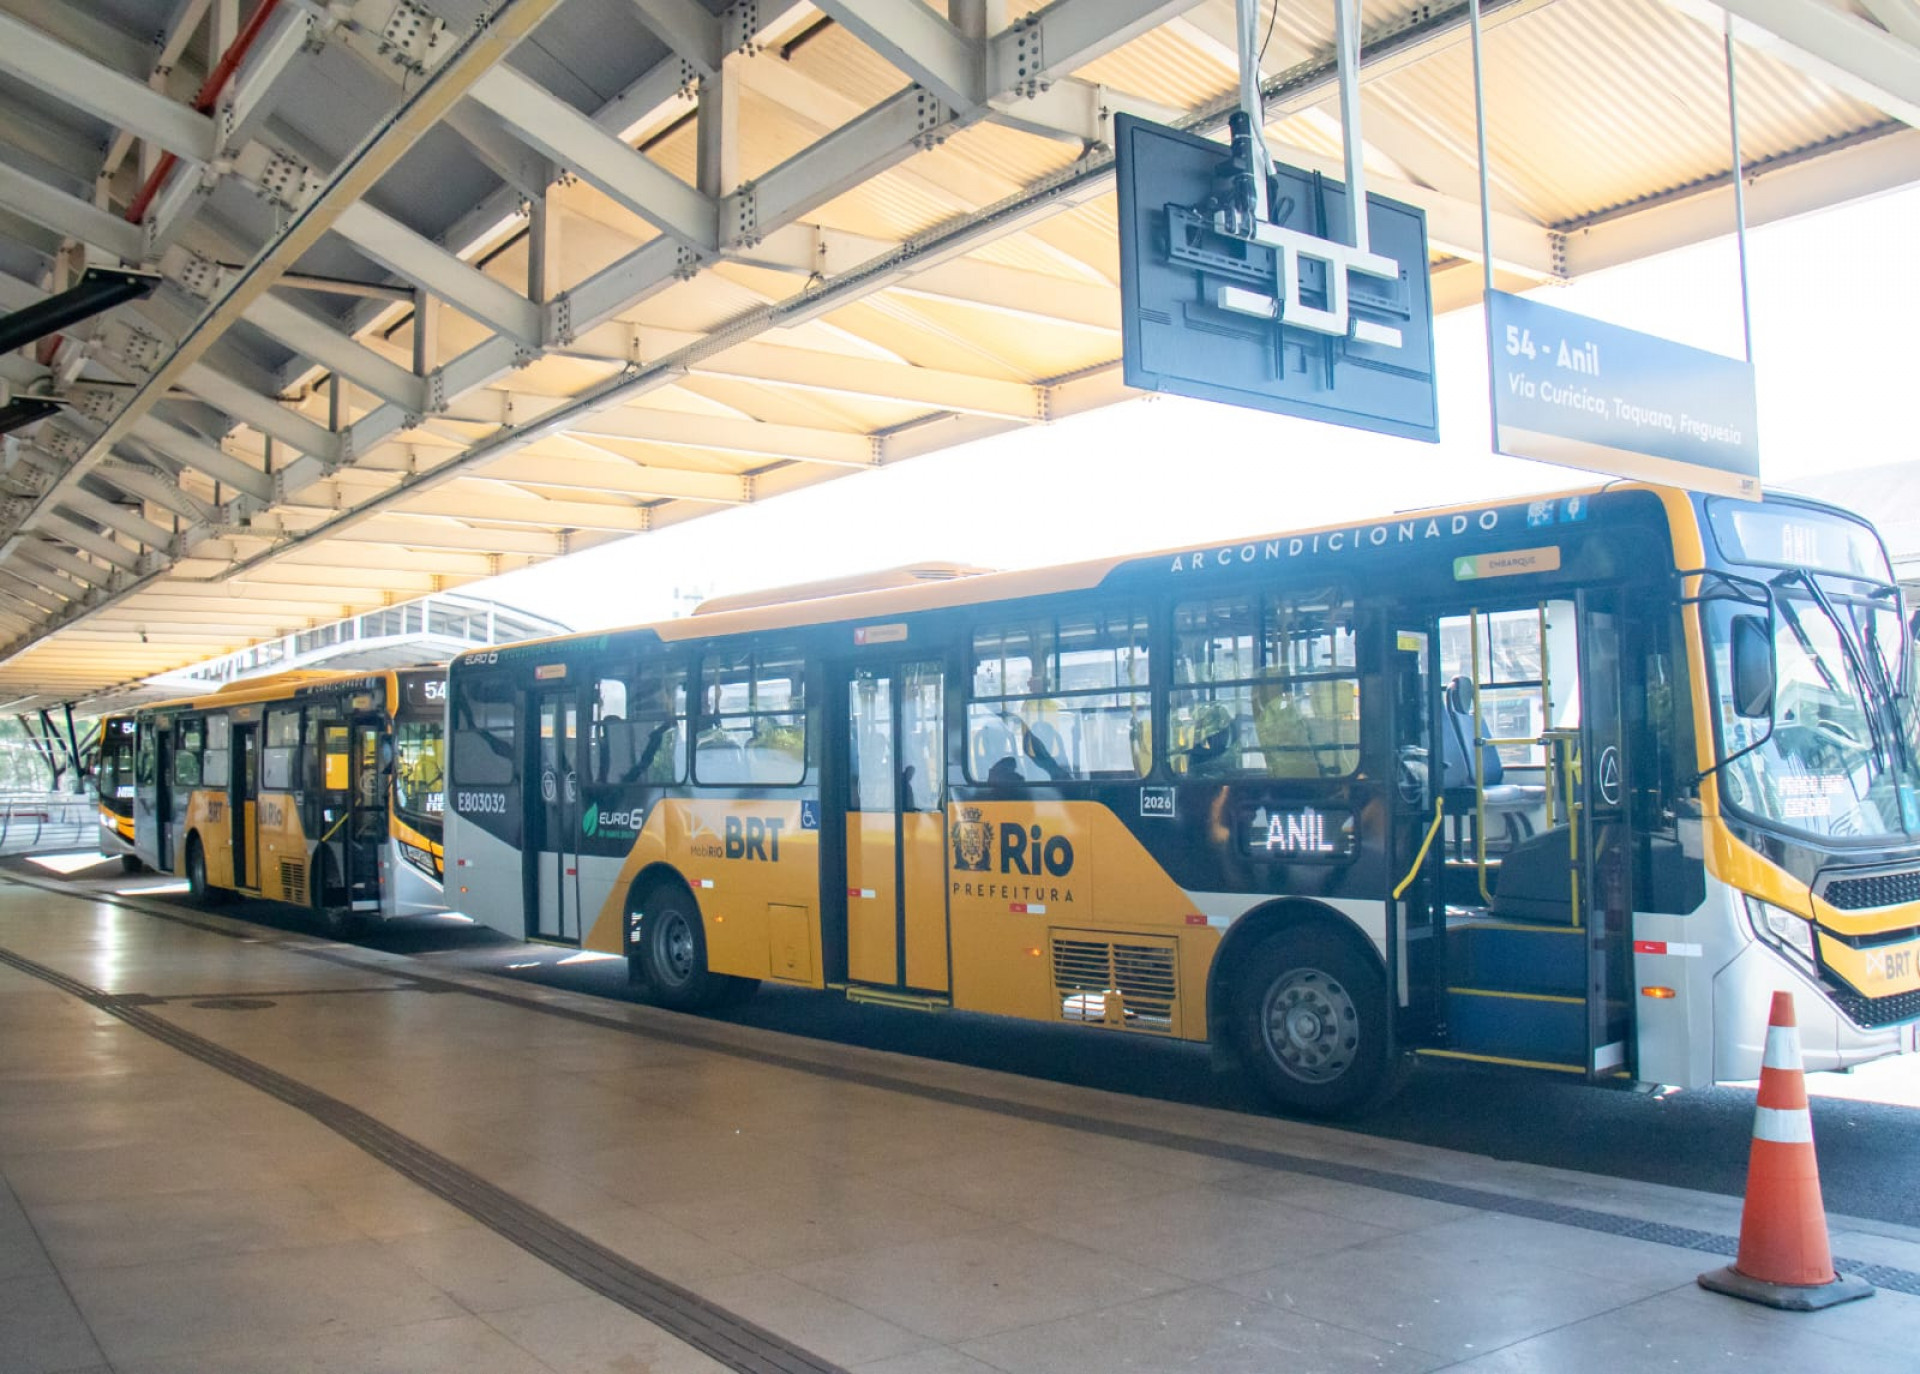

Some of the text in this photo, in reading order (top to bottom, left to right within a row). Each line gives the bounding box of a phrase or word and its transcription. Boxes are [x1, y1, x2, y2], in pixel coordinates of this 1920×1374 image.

[1505, 324, 1537, 361] 54
[1556, 338, 1600, 377] Anil
[1507, 371, 1742, 446] Via Curicica, Taquara, Freguesia
[1170, 510, 1499, 573] AR CONDICIONADO
[457, 791, 506, 814] E803032
[1143, 796, 1171, 809] 2026
[725, 815, 785, 863] BRT
[1000, 822, 1075, 877] Rio
[1266, 814, 1334, 852] ANIL
[953, 882, 1075, 903] PREFEITURA
[1885, 950, 1911, 980] BRT
